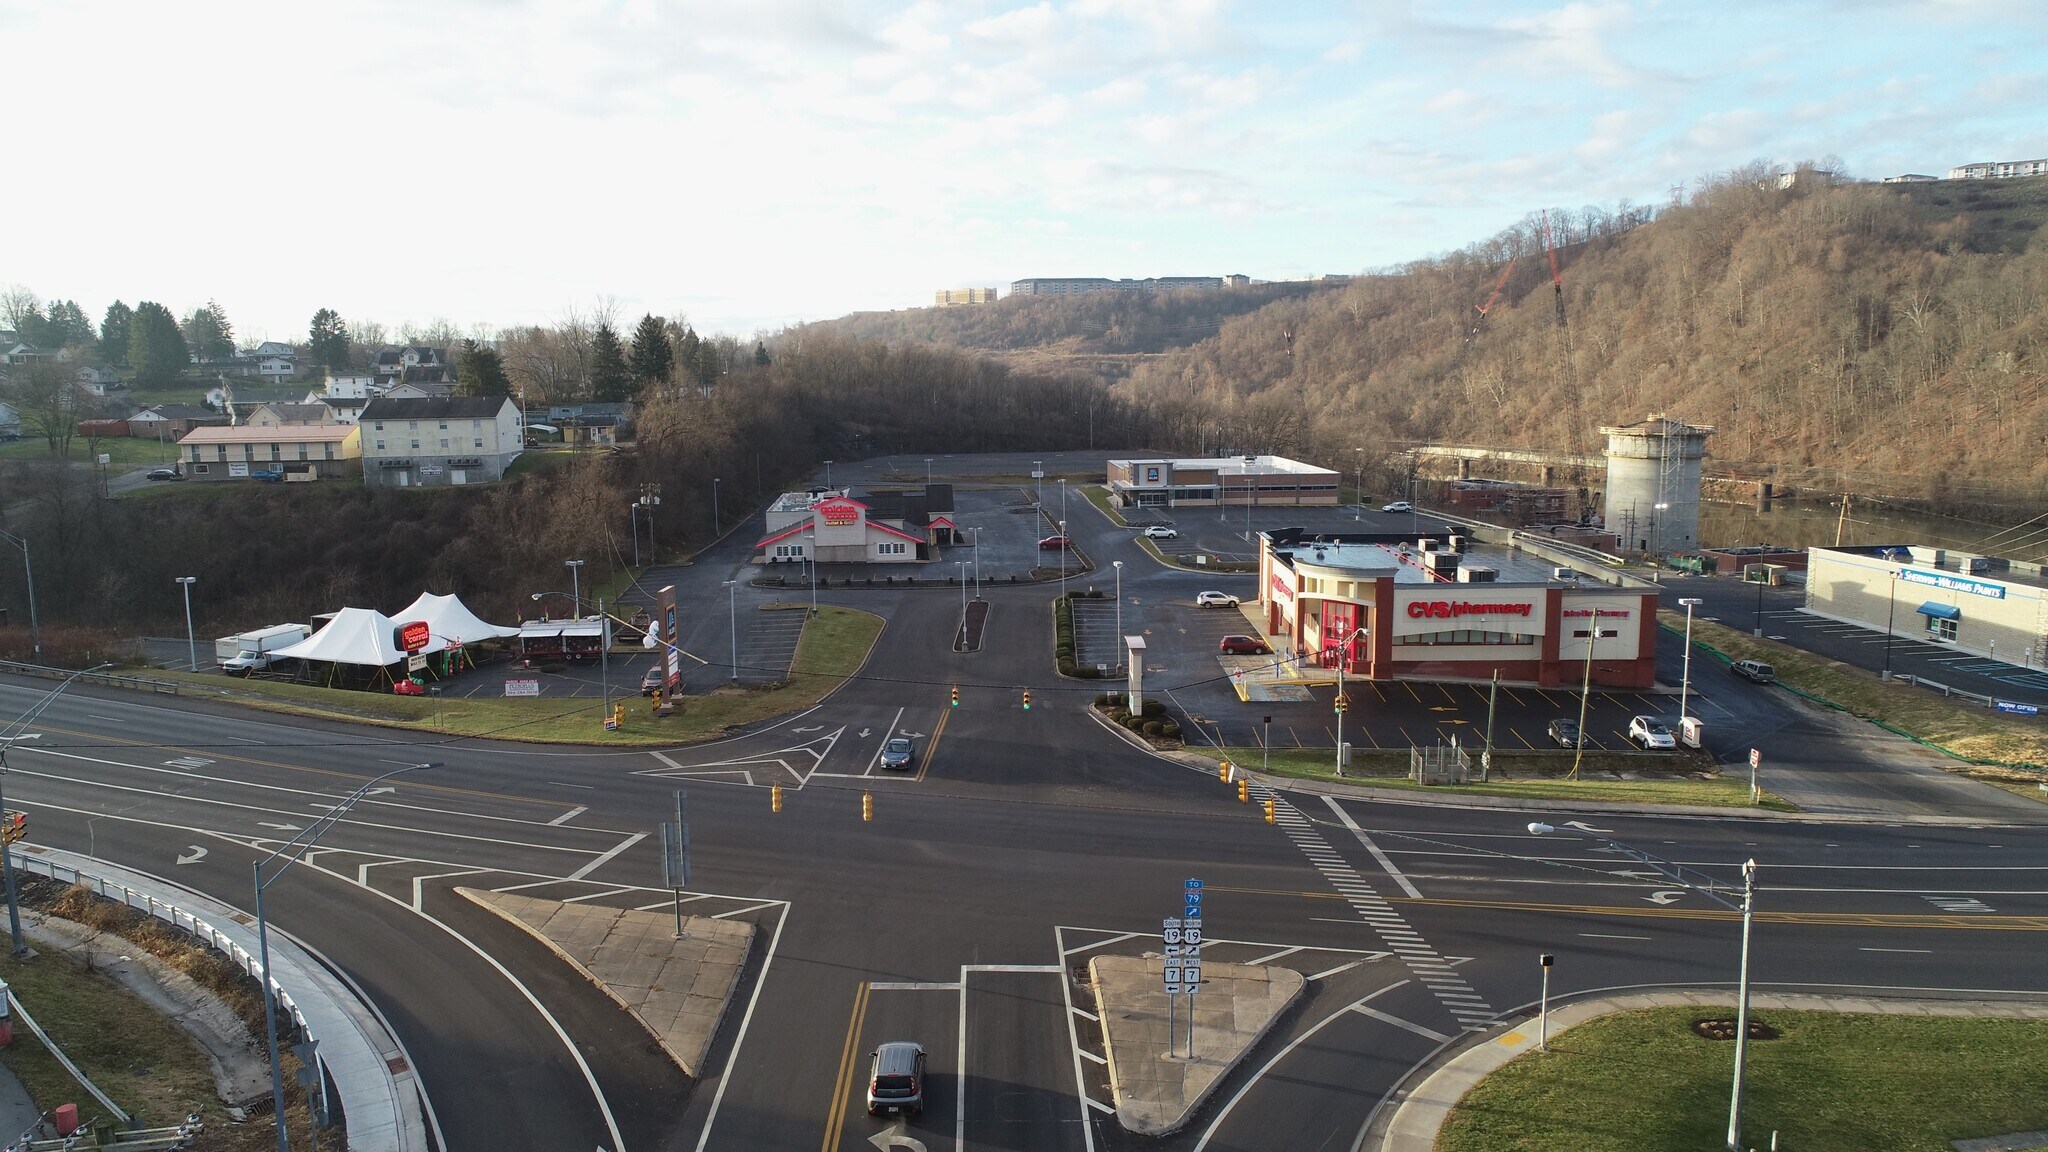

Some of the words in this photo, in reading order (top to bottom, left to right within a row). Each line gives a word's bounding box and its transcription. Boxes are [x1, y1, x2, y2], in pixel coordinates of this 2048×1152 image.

[1973, 584, 2001, 598] PAINTS
[1408, 601, 1532, 618] CVS/pharmacy
[404, 626, 426, 640] golden
[408, 631, 428, 643] corral
[1188, 895, 1199, 903] 79
[1167, 931, 1178, 941] 19
[1188, 931, 1199, 941] 19
[1170, 970, 1176, 980] 7
[1189, 970, 1195, 980] 7
